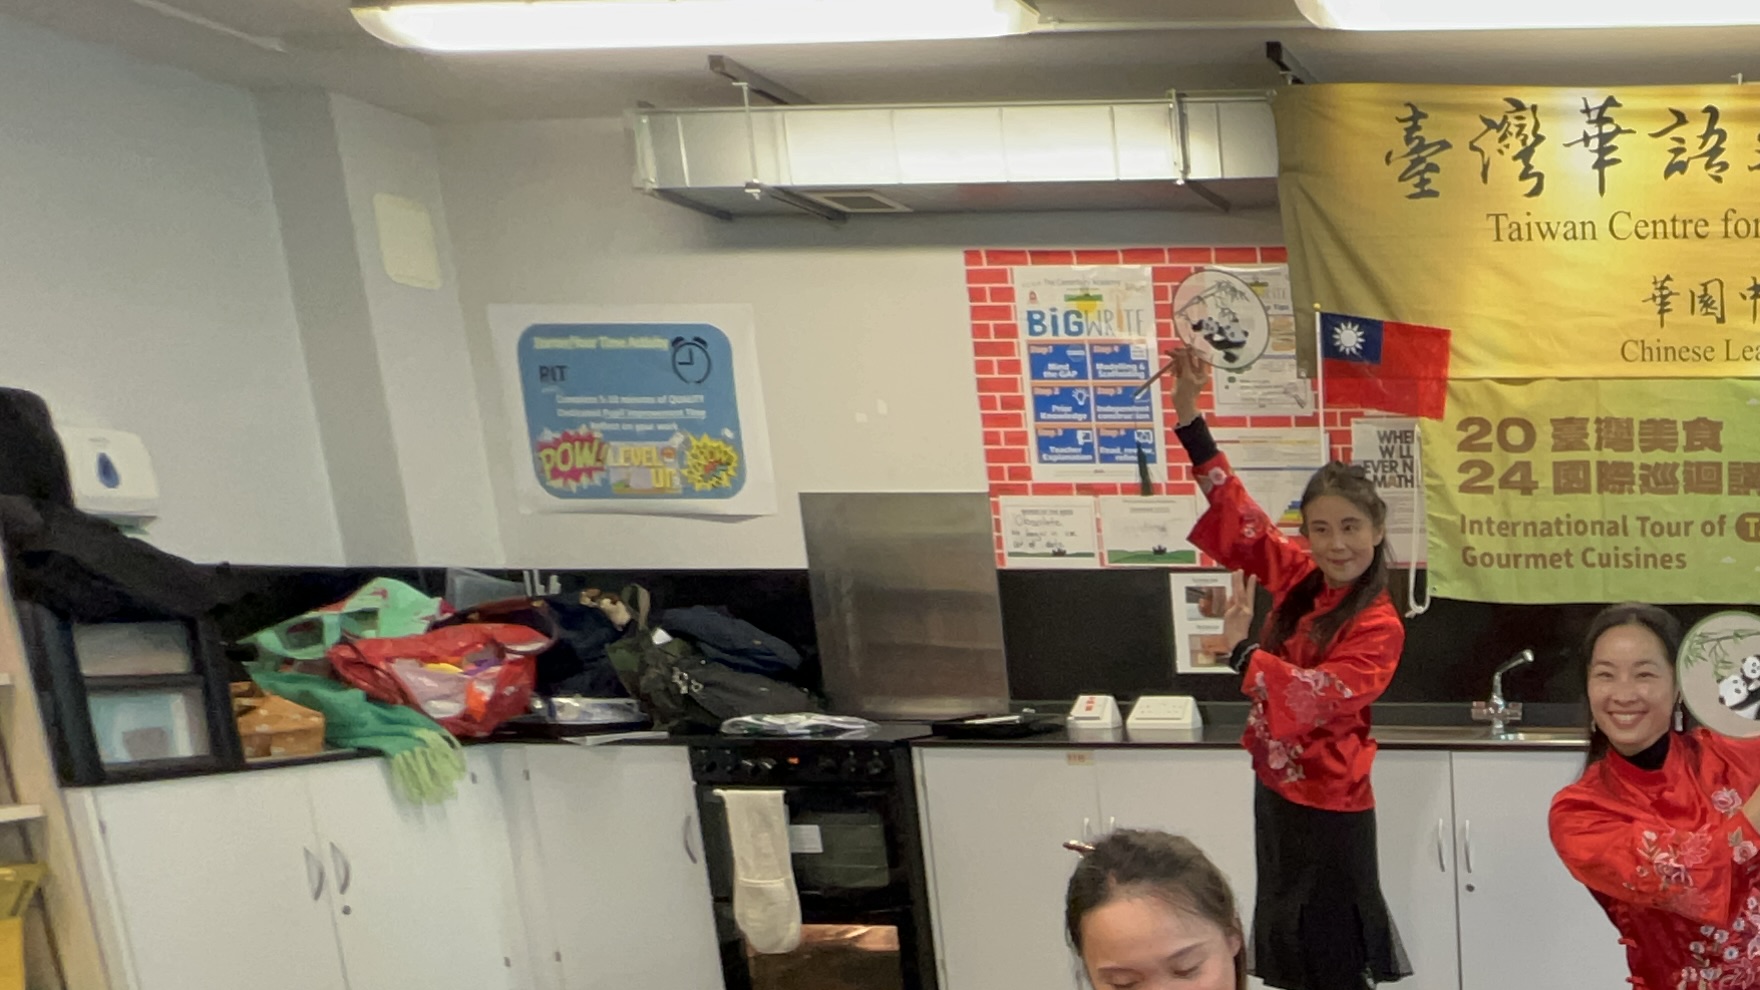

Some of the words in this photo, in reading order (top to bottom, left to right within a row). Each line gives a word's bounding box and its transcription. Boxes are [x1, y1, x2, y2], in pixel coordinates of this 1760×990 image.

[1486, 211, 1598, 243] Taiwan
[1607, 210, 1710, 242] Centre
[1620, 339, 1716, 363] Chinese
[1456, 416, 1537, 453] 20
[1549, 416, 1724, 454] 臺灣美食
[539, 438, 610, 481] POW!
[1363, 459, 1399, 474] EVER
[1456, 459, 1539, 495] 24
[1459, 514, 1629, 538] International
[1635, 515, 1695, 538] Tour
[1700, 514, 1728, 538] of
[1461, 547, 1574, 570] Gourmet
[1581, 546, 1688, 570] Cuisines
